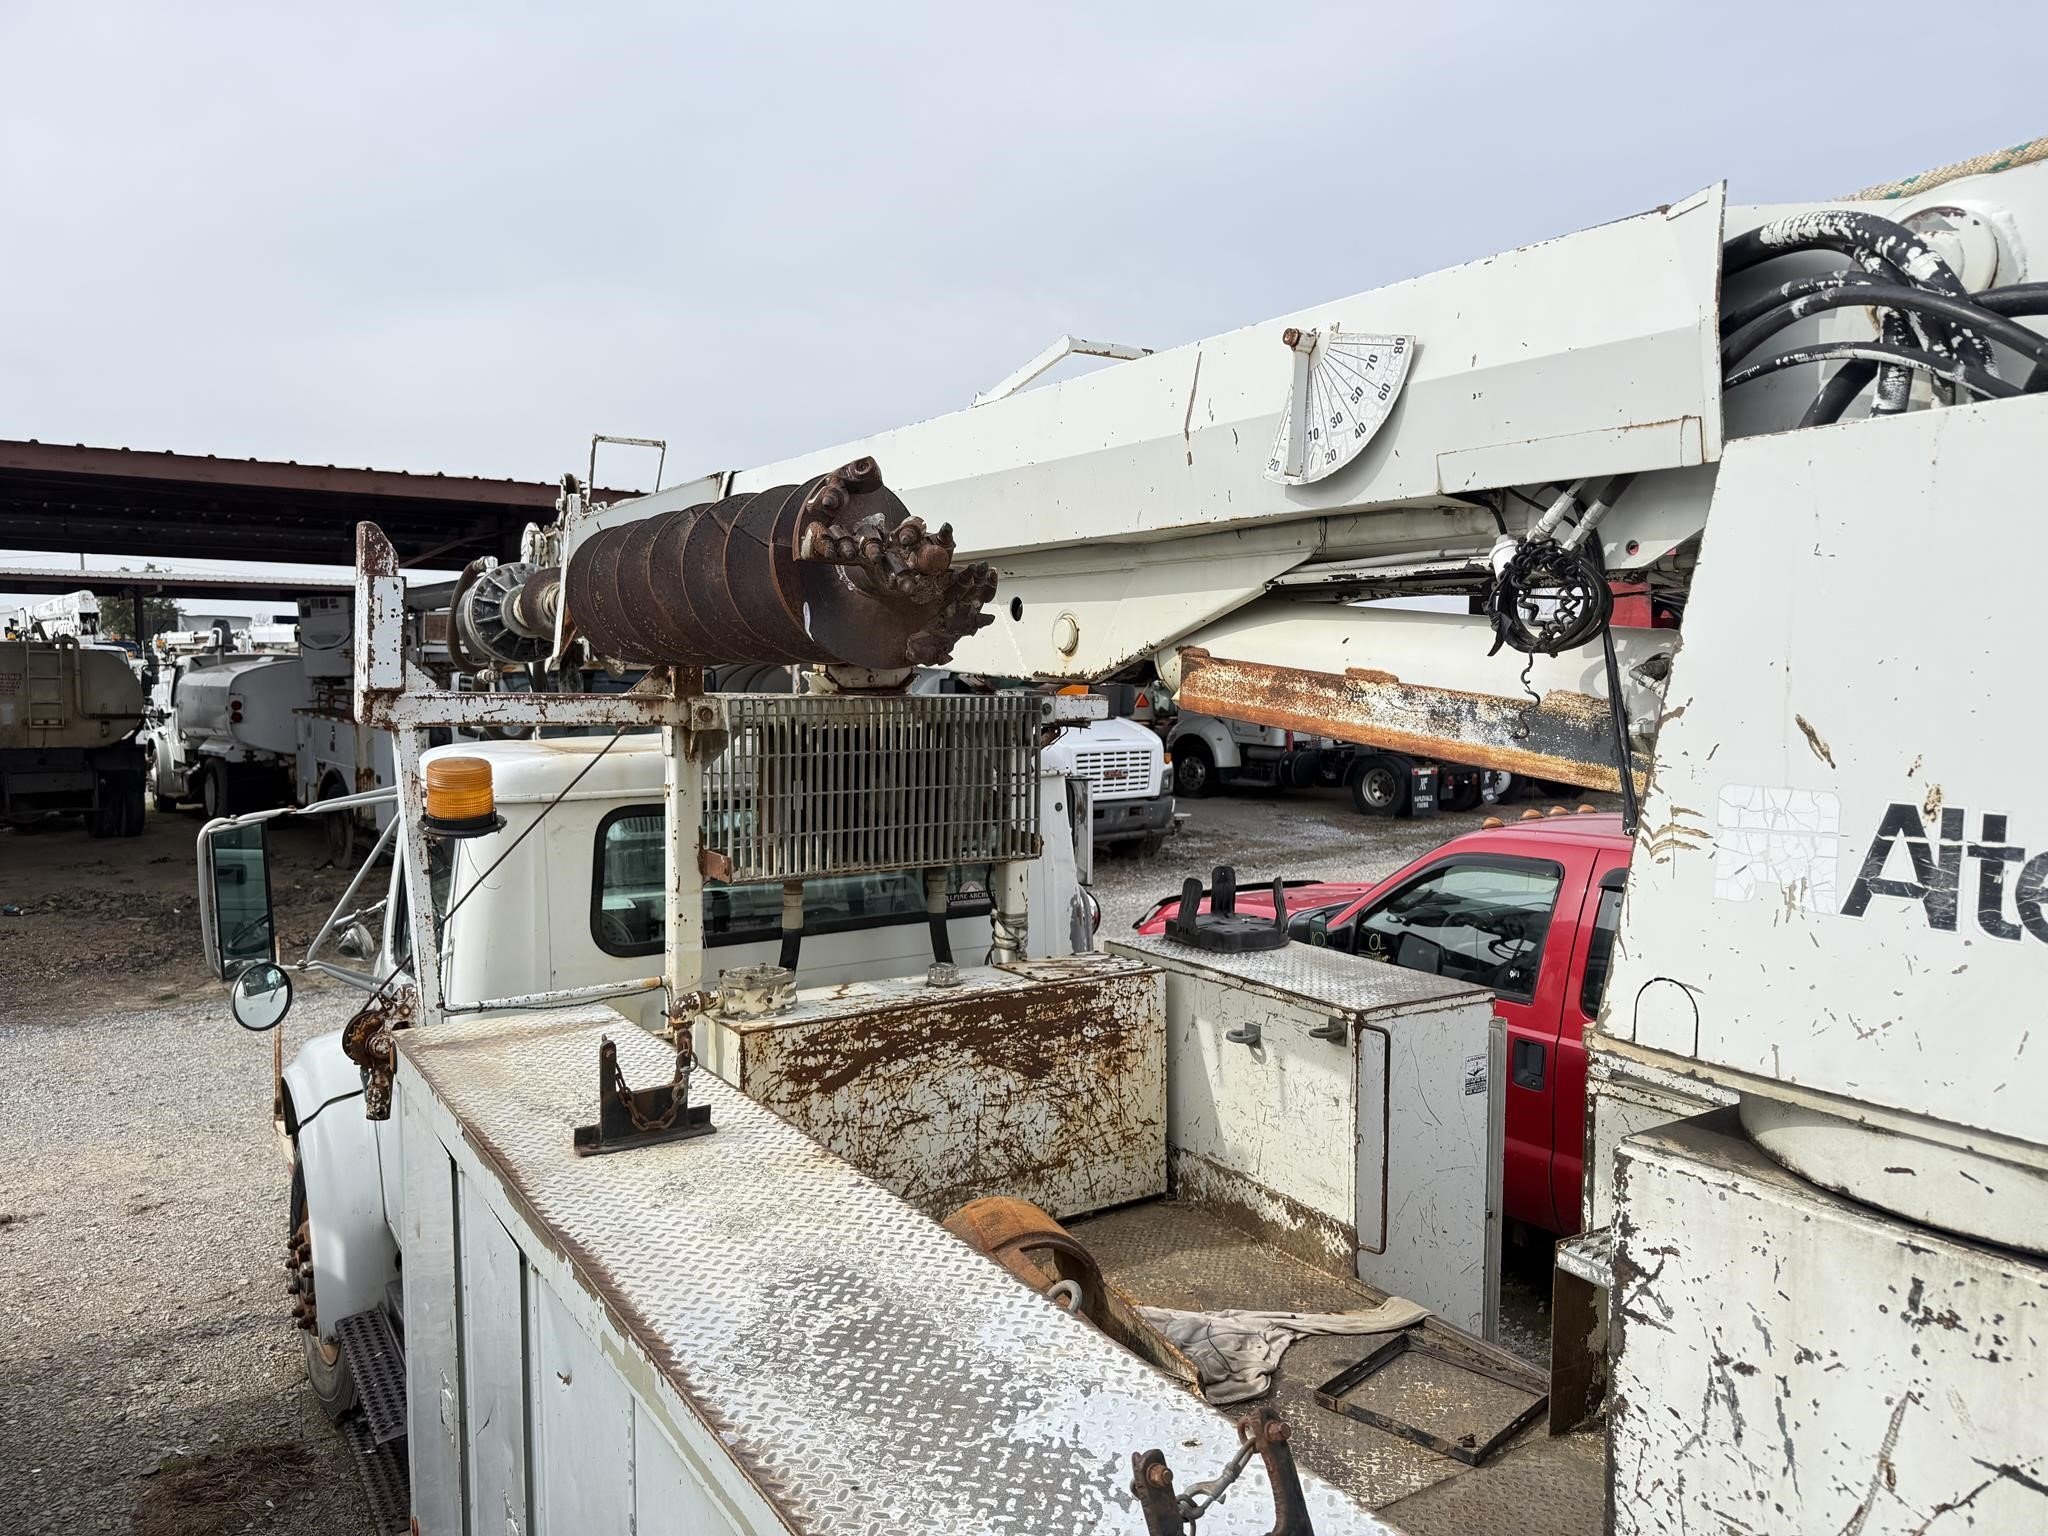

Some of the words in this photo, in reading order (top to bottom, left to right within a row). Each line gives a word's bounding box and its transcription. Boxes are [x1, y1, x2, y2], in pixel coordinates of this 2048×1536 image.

[1394, 337, 1406, 354] 80
[1365, 354, 1378, 371] 70
[1350, 386, 1364, 405] 50
[1377, 383, 1391, 401] 60
[1330, 411, 1343, 429] 30
[1307, 427, 1319, 441] 10
[1354, 422, 1367, 439] 40
[1324, 449, 1337, 465] 20
